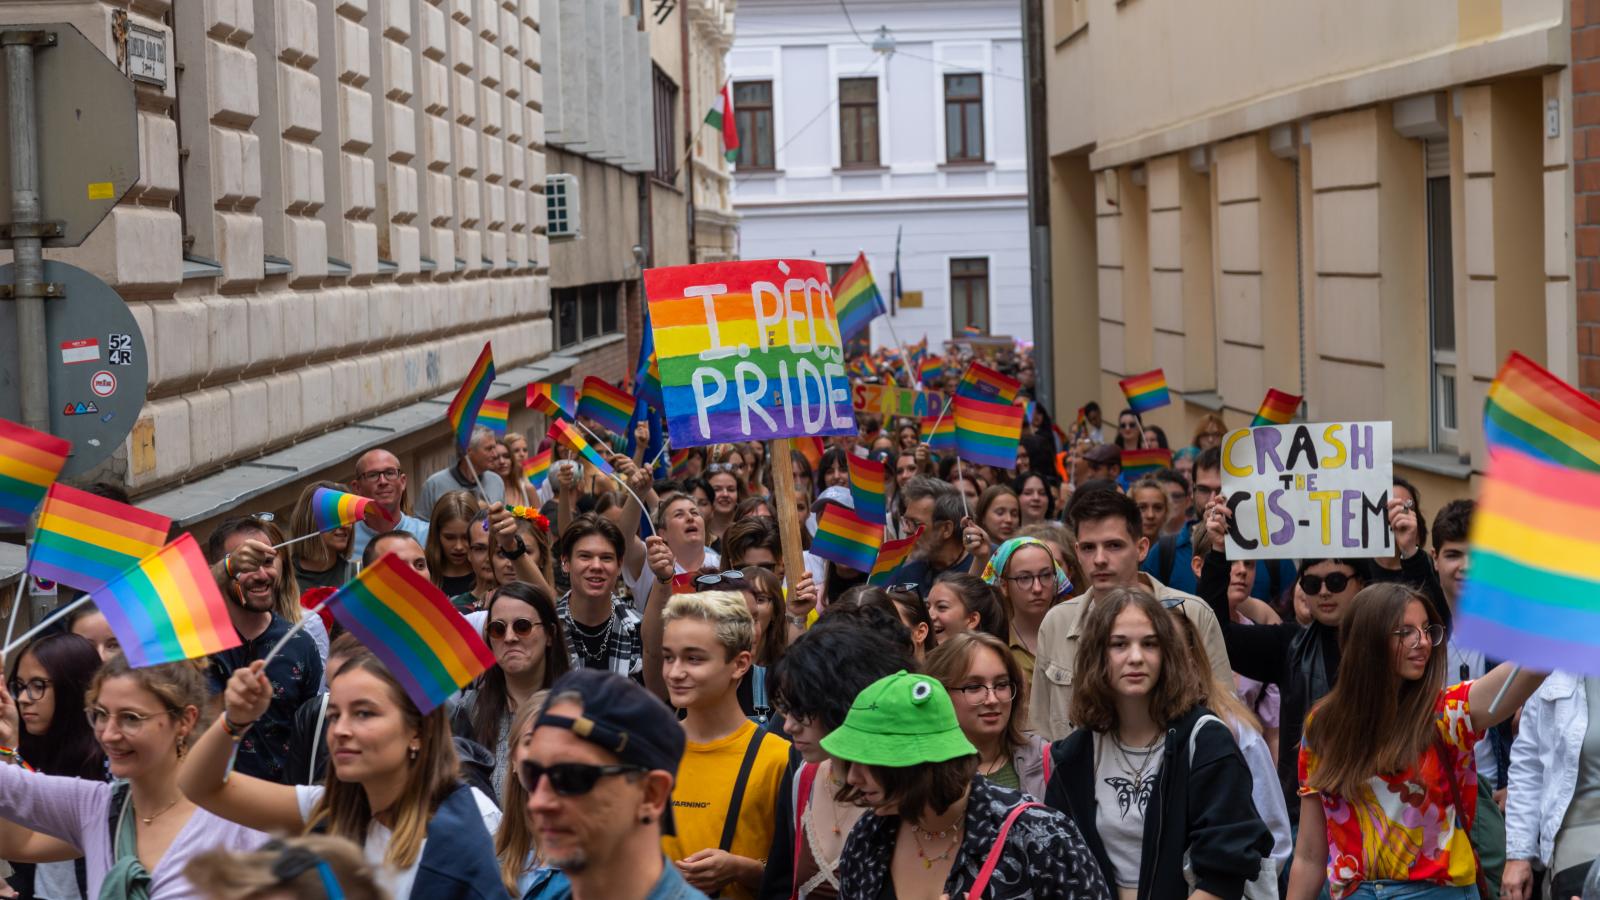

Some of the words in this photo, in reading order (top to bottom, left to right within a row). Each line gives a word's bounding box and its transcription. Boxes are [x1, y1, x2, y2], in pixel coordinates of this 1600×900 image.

[110, 334, 131, 349] 52
[110, 350, 131, 364] 4R
[692, 357, 853, 439] PRIDE
[1222, 424, 1374, 477] CRASH
[1279, 473, 1318, 491] THE
[1226, 489, 1390, 550] CIS-TEM
